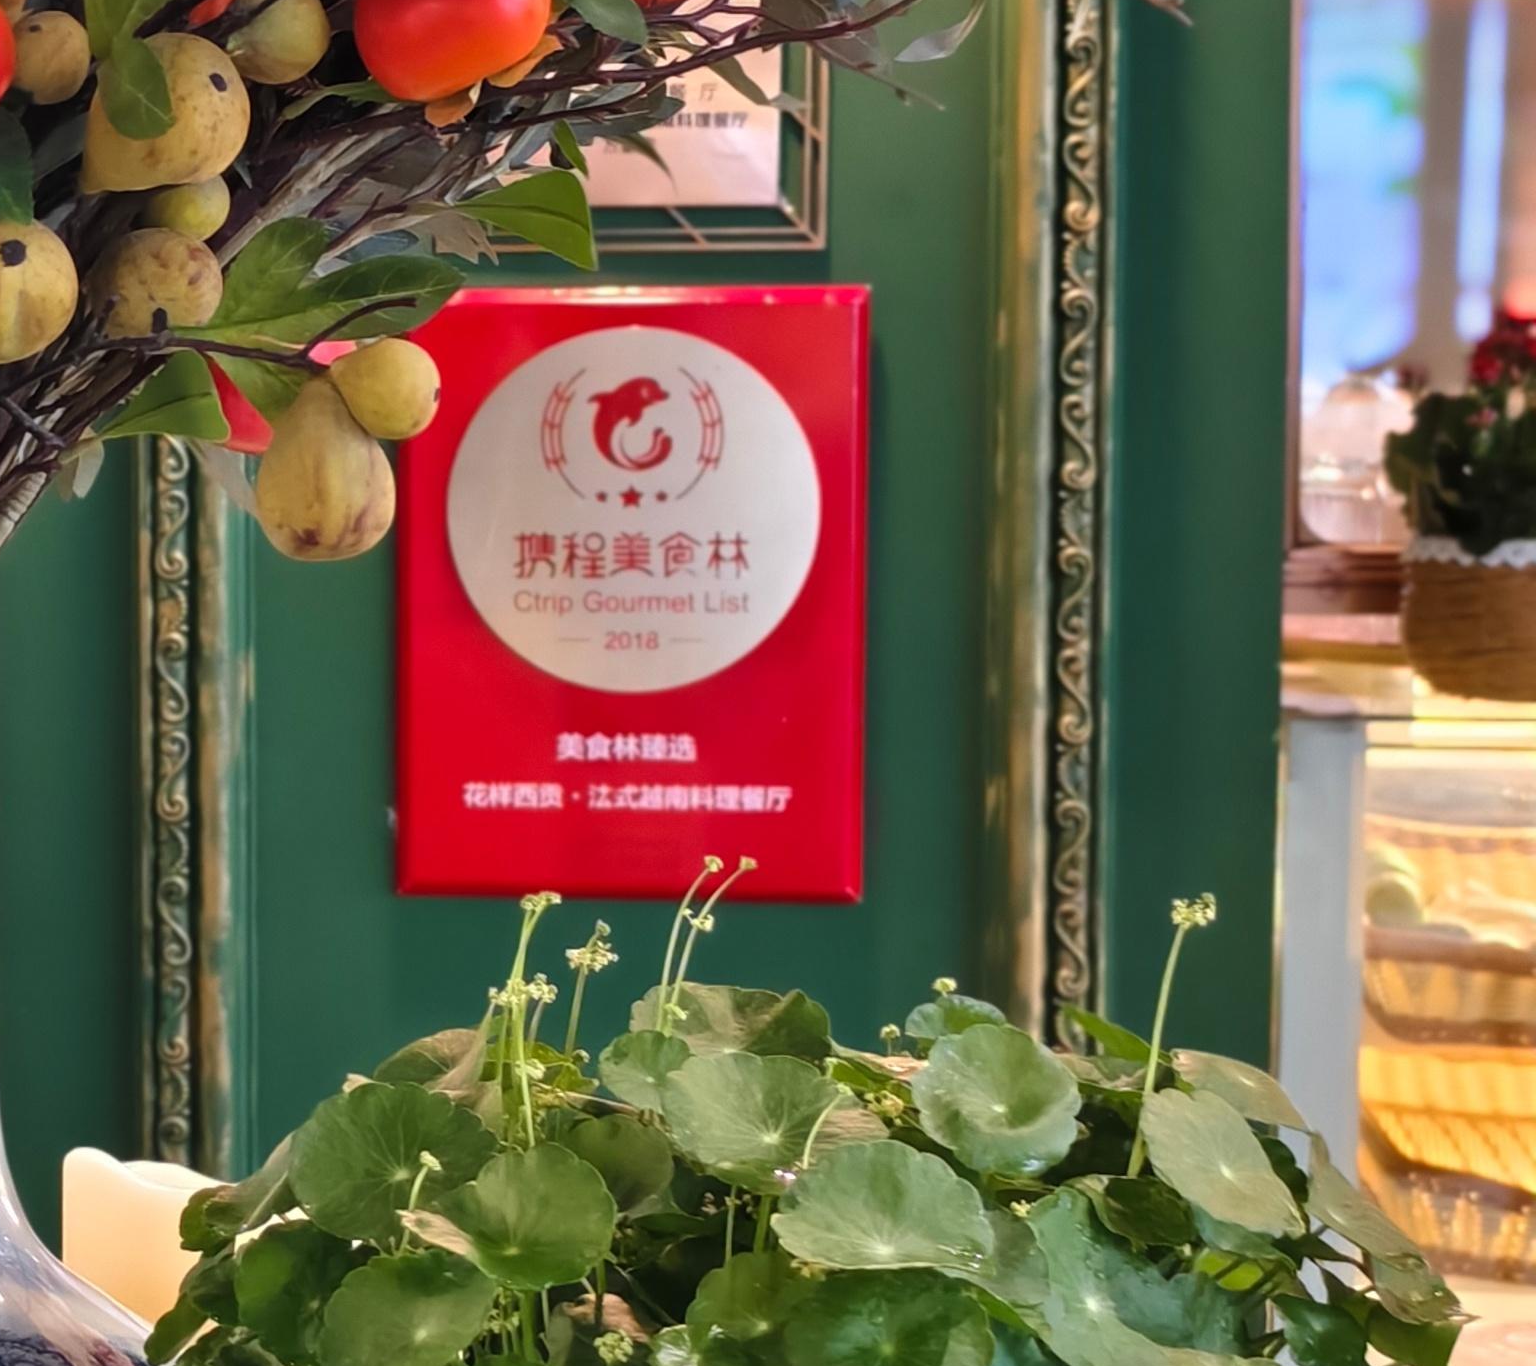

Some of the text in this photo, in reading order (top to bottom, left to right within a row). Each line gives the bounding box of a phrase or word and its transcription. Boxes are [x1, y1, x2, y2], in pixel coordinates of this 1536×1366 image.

[512, 532, 750, 580] 携程美食林
[513, 590, 751, 617] Ctrip Gourmet List
[604, 631, 660, 651] 2018
